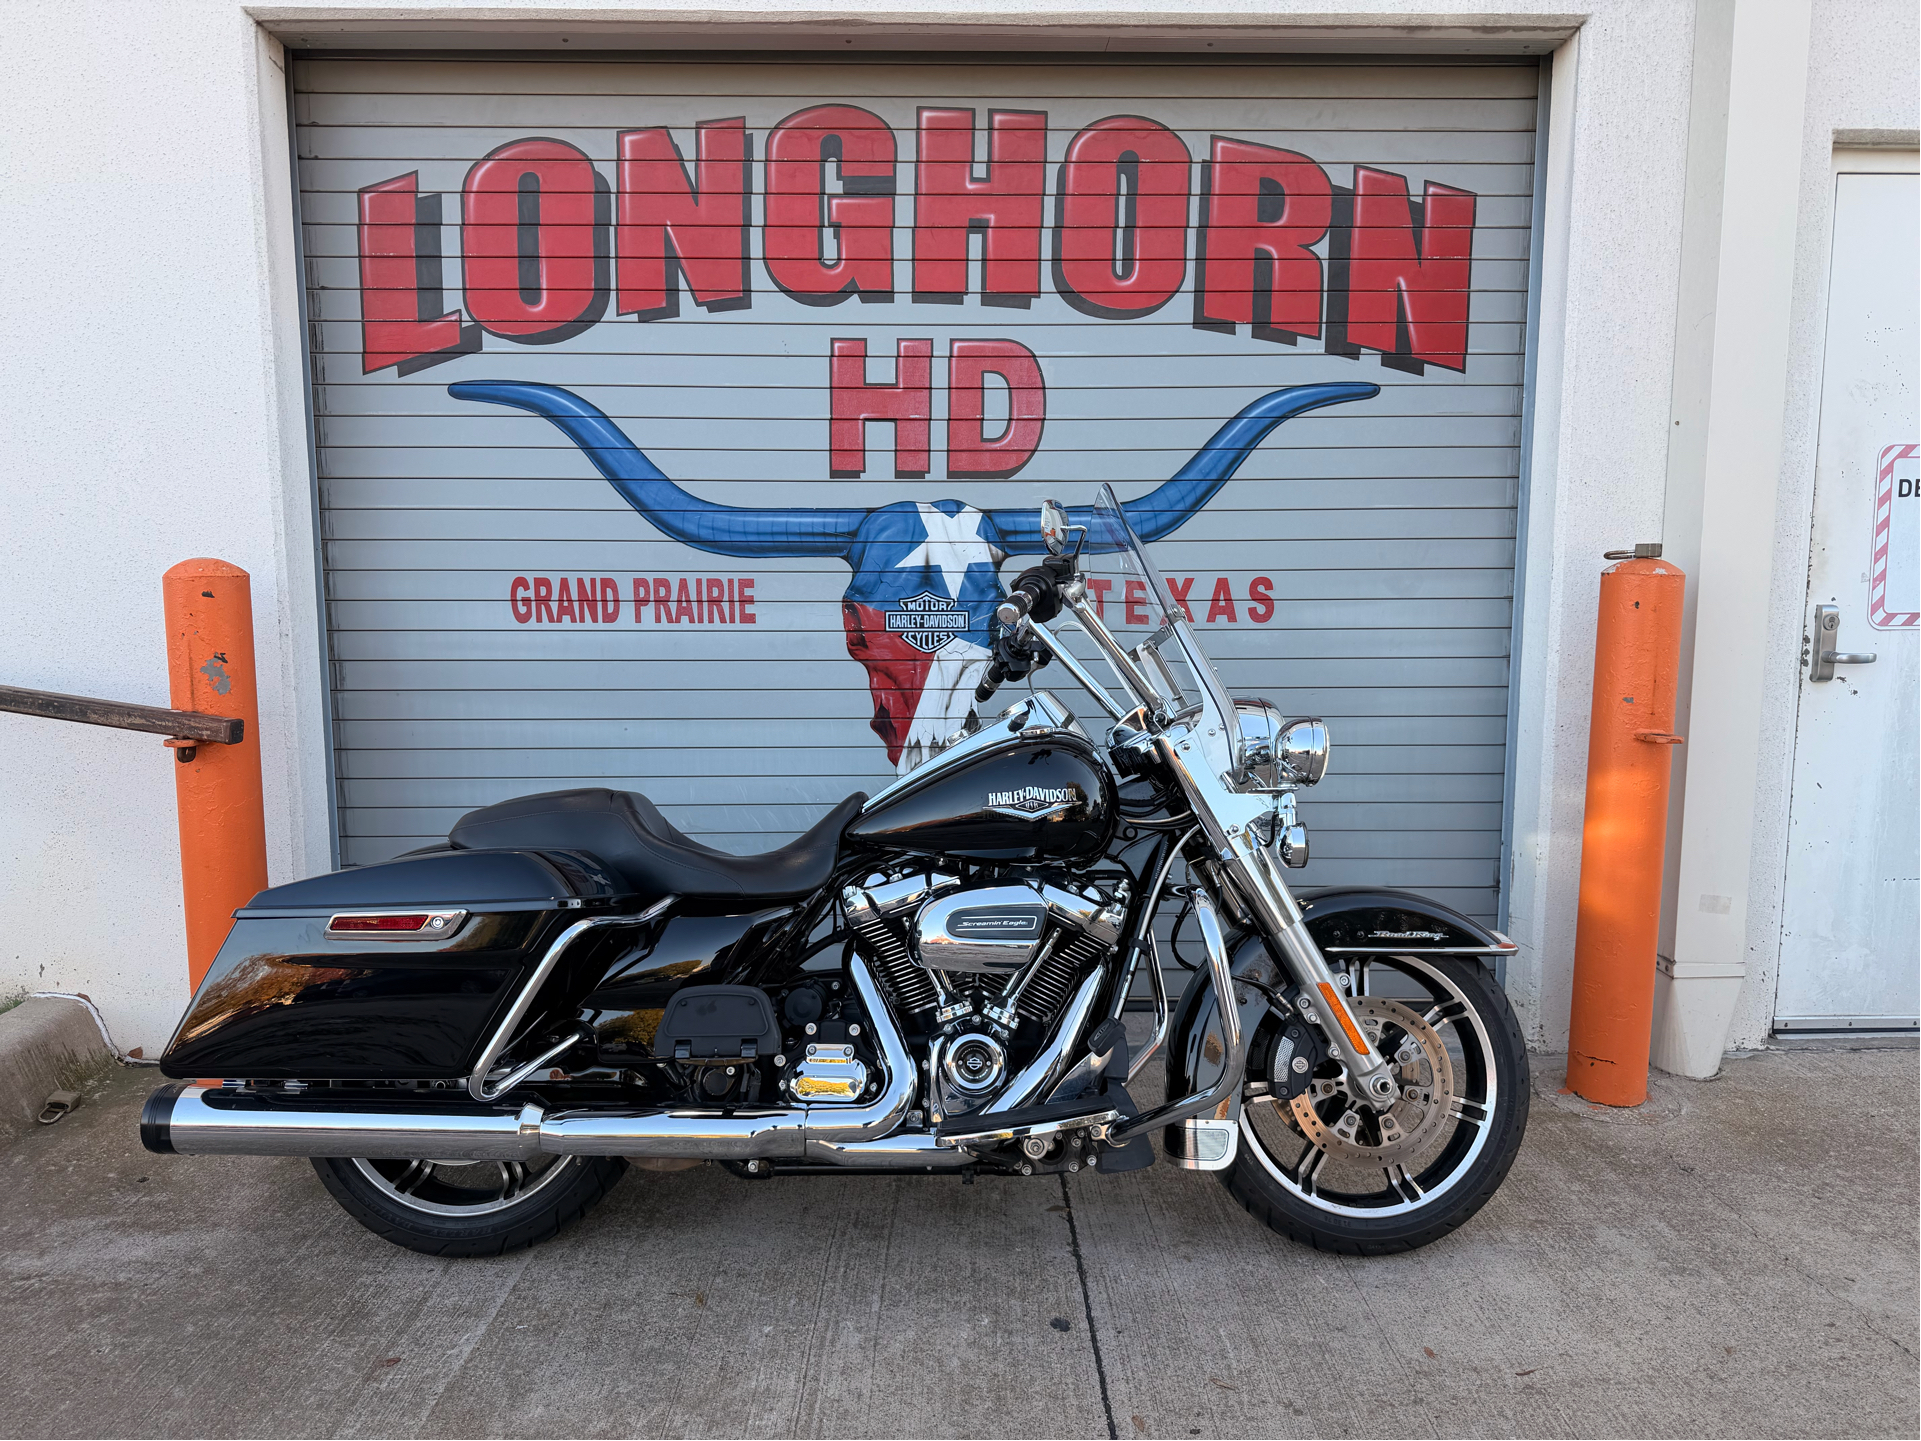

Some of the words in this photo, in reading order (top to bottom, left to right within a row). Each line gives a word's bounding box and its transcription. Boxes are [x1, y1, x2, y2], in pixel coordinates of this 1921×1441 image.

[357, 103, 1477, 378] LONGHORN
[829, 337, 1046, 479] HD
[510, 576, 621, 624] GRAND
[632, 577, 757, 624] PRAIRIE
[907, 595, 947, 611] MOTOR
[1086, 576, 1275, 625] TEXAS
[889, 613, 965, 628] HARLEY-DAVIDSON
[907, 631, 948, 649] CYCLES
[988, 786, 1077, 806] HARLEY-DAVIDSON
